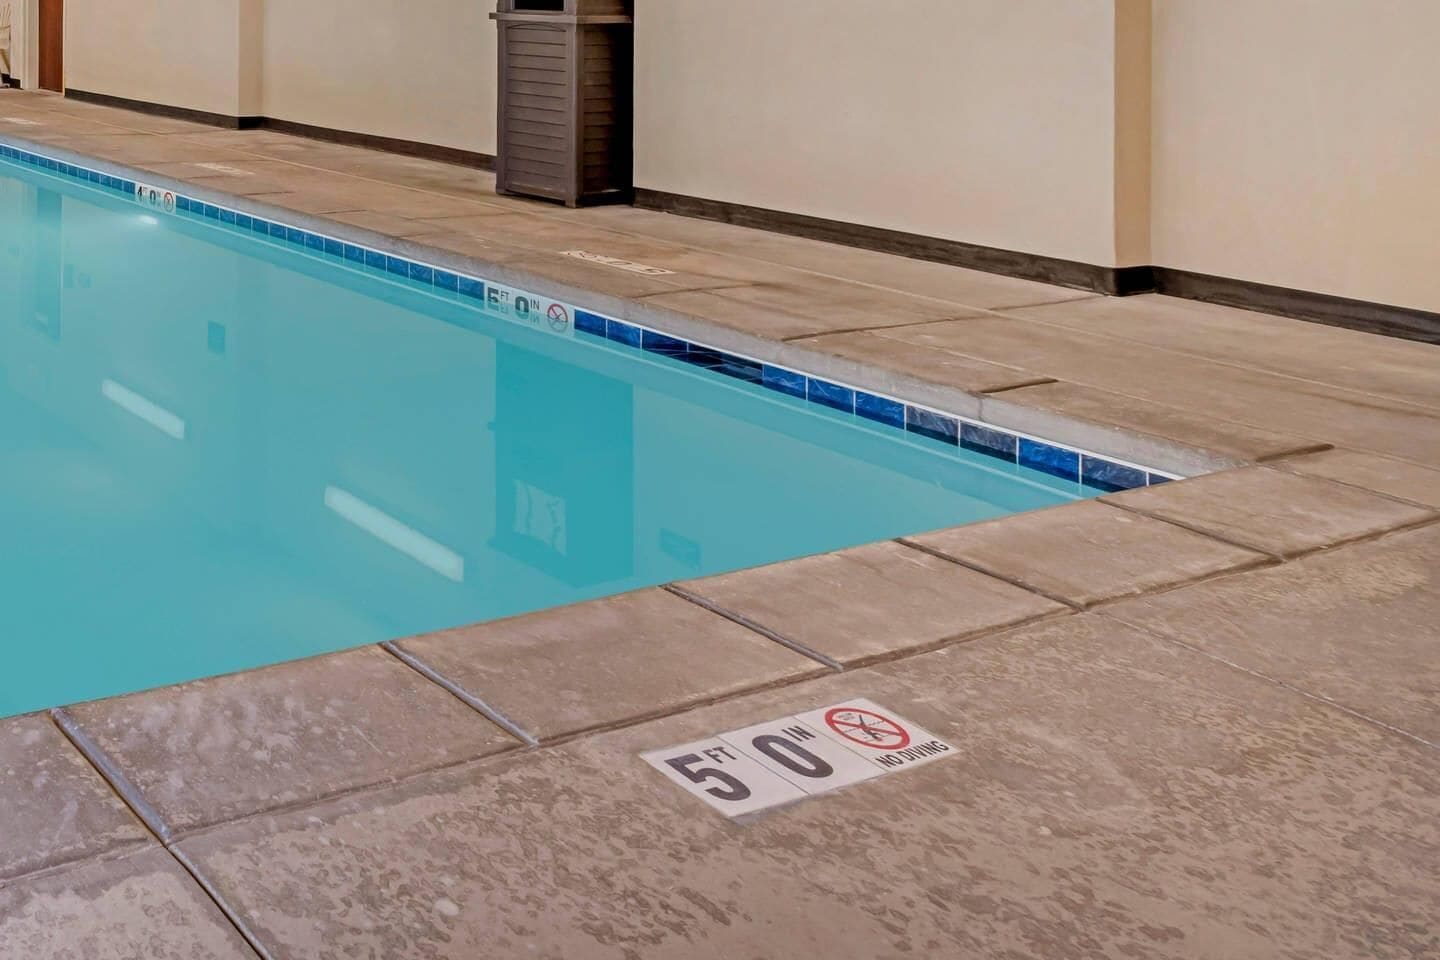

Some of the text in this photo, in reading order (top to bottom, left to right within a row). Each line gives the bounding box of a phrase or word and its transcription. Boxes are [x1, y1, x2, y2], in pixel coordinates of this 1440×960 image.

[487, 287, 540, 313] 5 FT 0 IN
[664, 725, 834, 801] 5 FT 0 IN
[875, 741, 949, 768] NO DIVING
